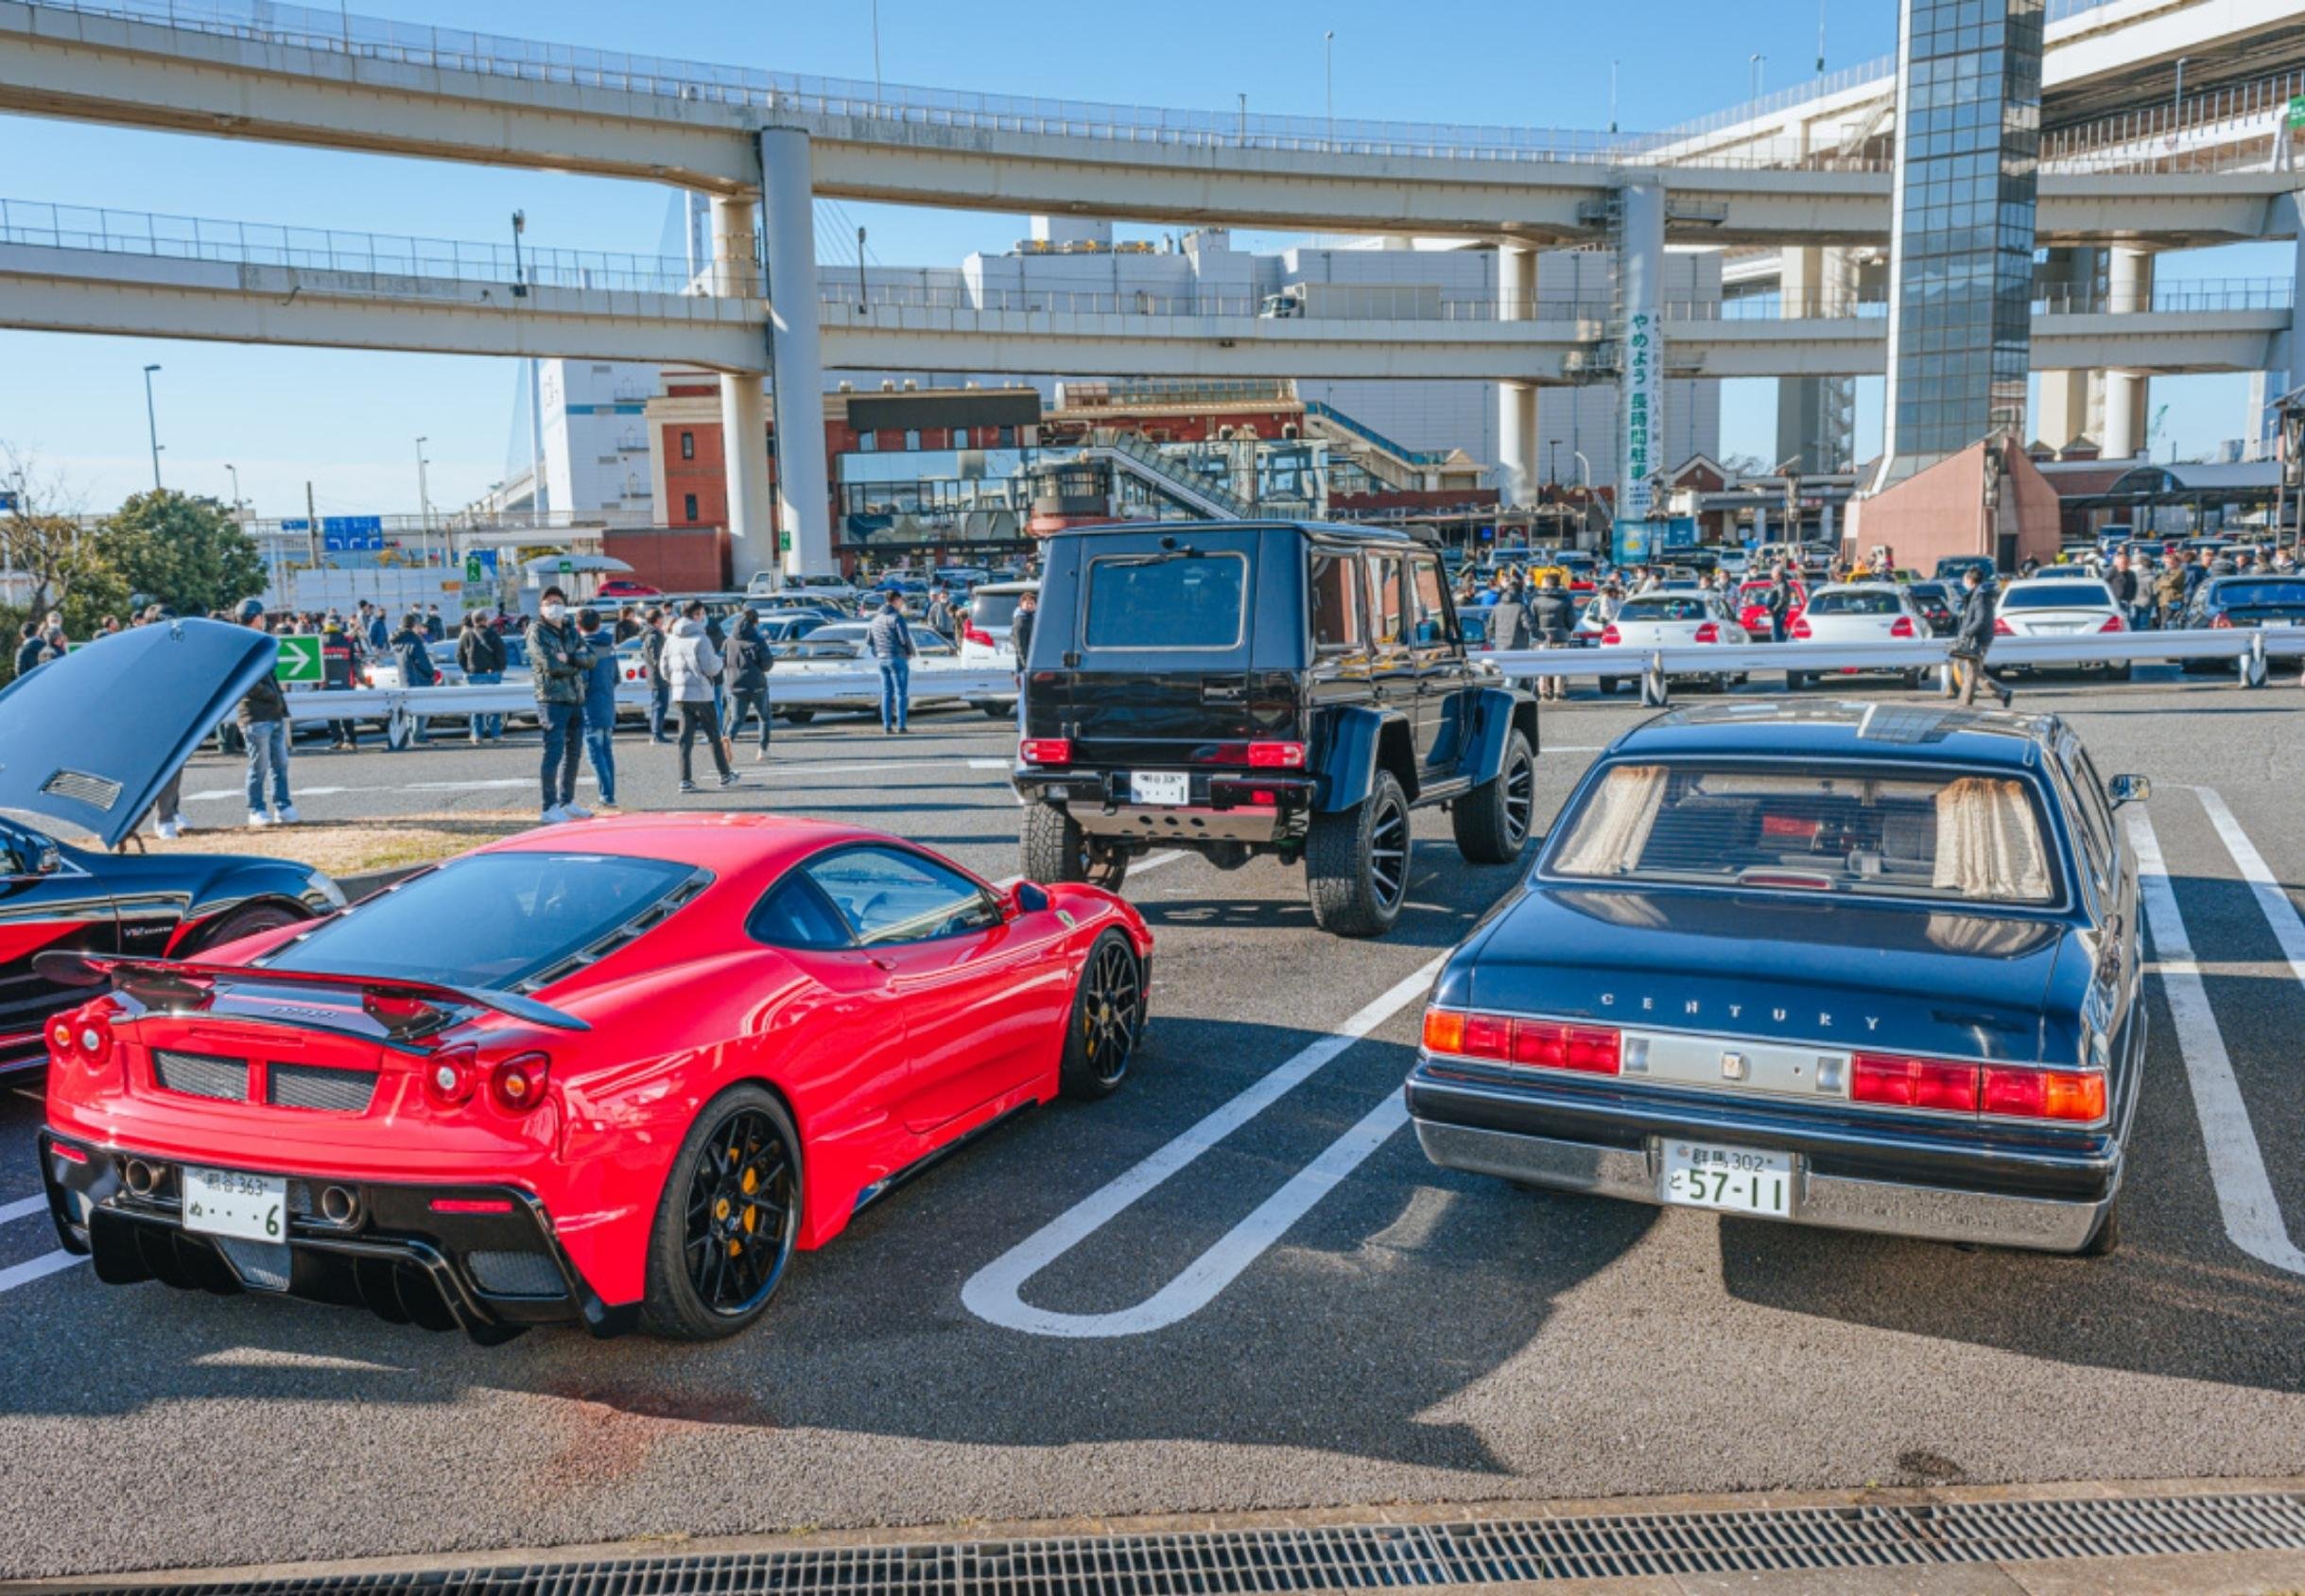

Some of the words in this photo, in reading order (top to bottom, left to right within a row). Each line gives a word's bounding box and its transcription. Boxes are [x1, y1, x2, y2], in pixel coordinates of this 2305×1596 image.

[1631, 314, 1649, 384] やめよう
[1630, 392, 1648, 480] 長時間駐車
[1601, 993, 1880, 1031] CENTURY
[1690, 1169, 1781, 1210] 57-11
